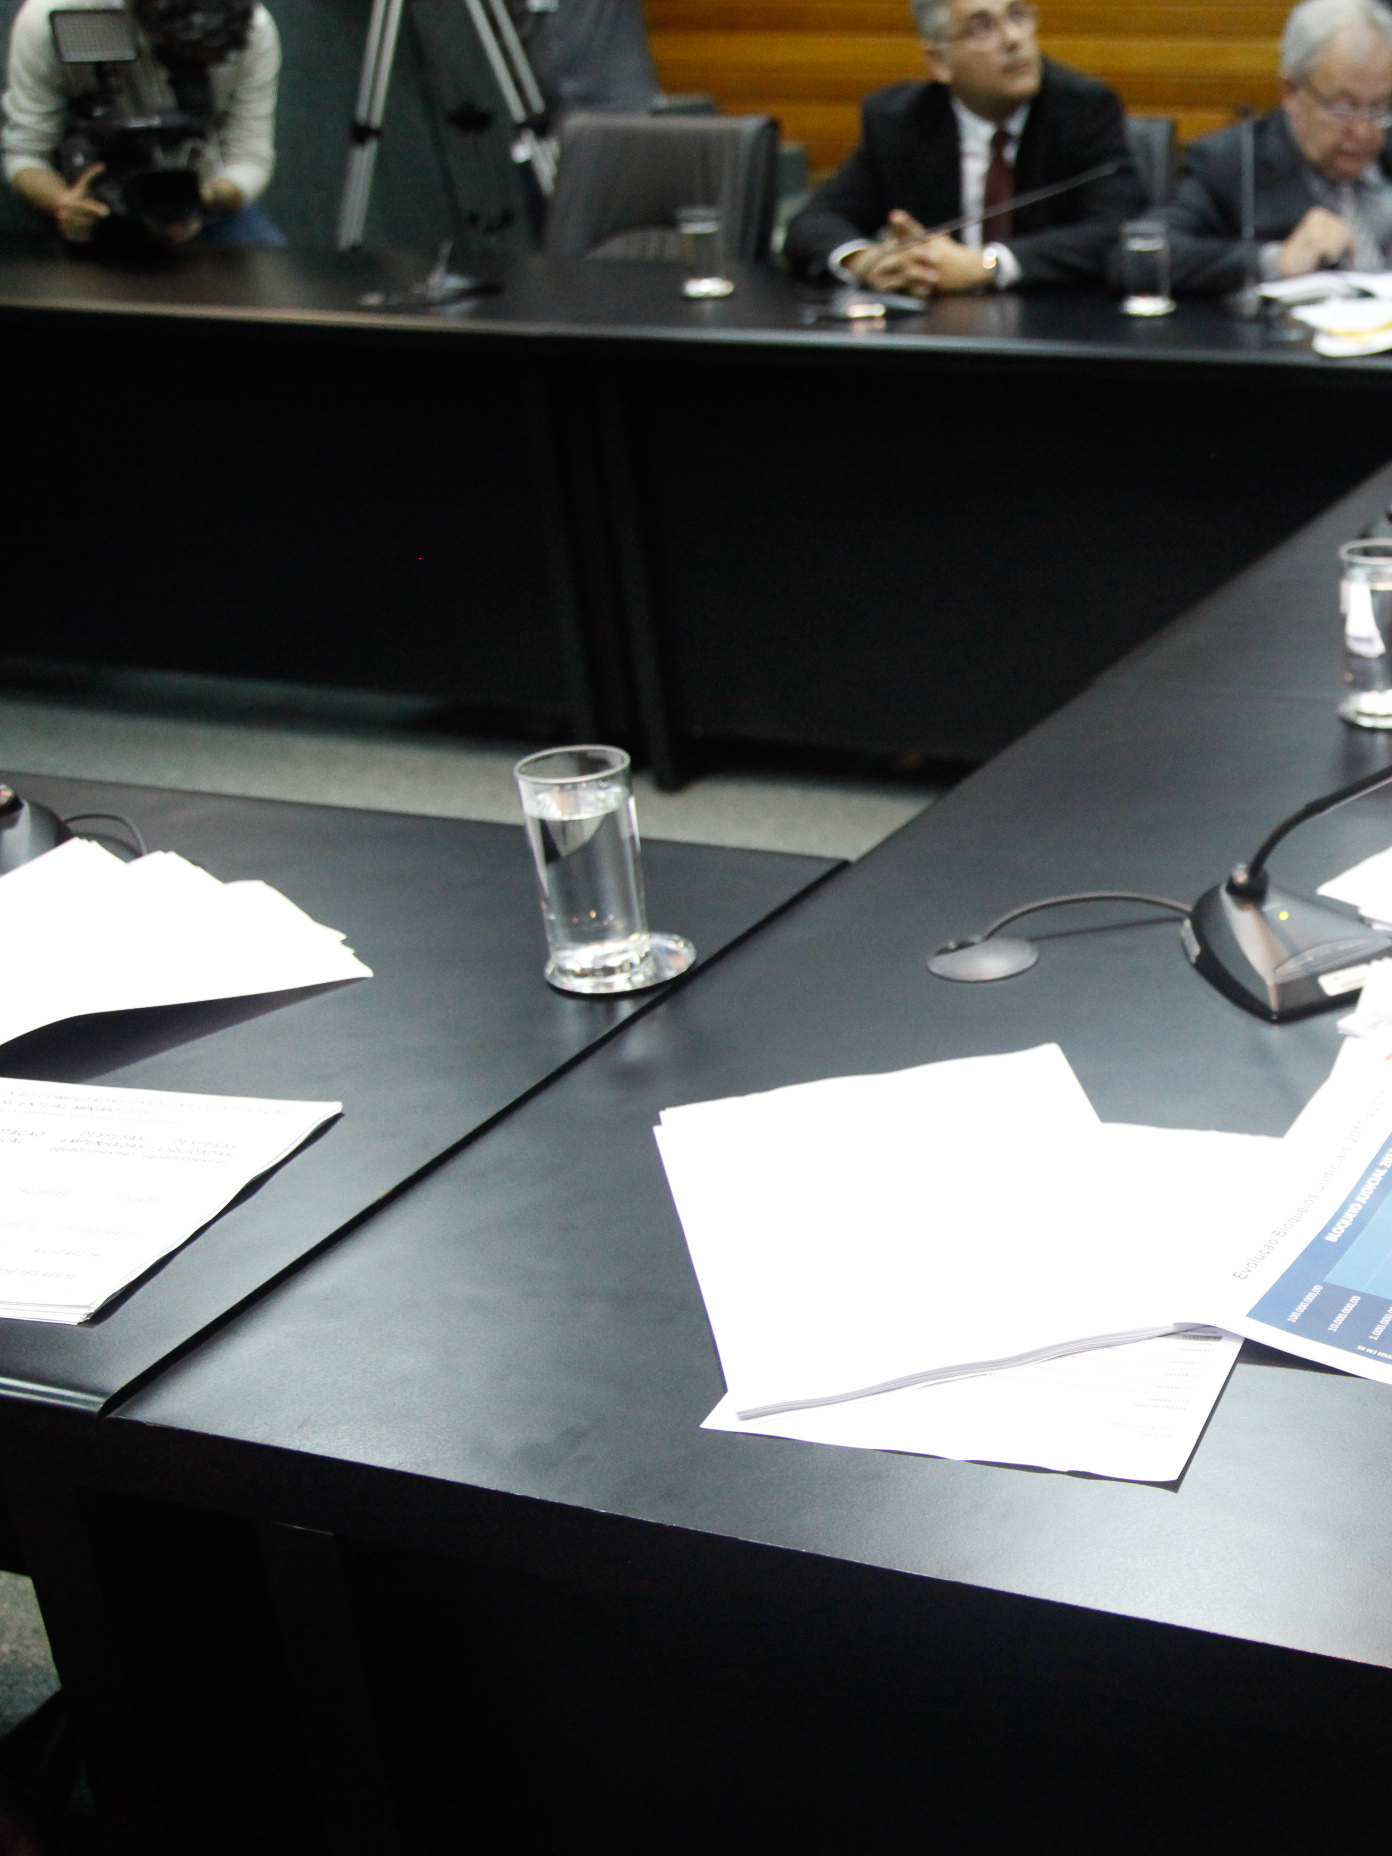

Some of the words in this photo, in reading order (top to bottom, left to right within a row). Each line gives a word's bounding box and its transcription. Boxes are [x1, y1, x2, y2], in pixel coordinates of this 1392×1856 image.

[1324, 1203, 1363, 1242] BLOQUEIO
[1354, 1168, 1388, 1203] JUDICIAL
[1231, 1238, 1280, 1280] Evolução
